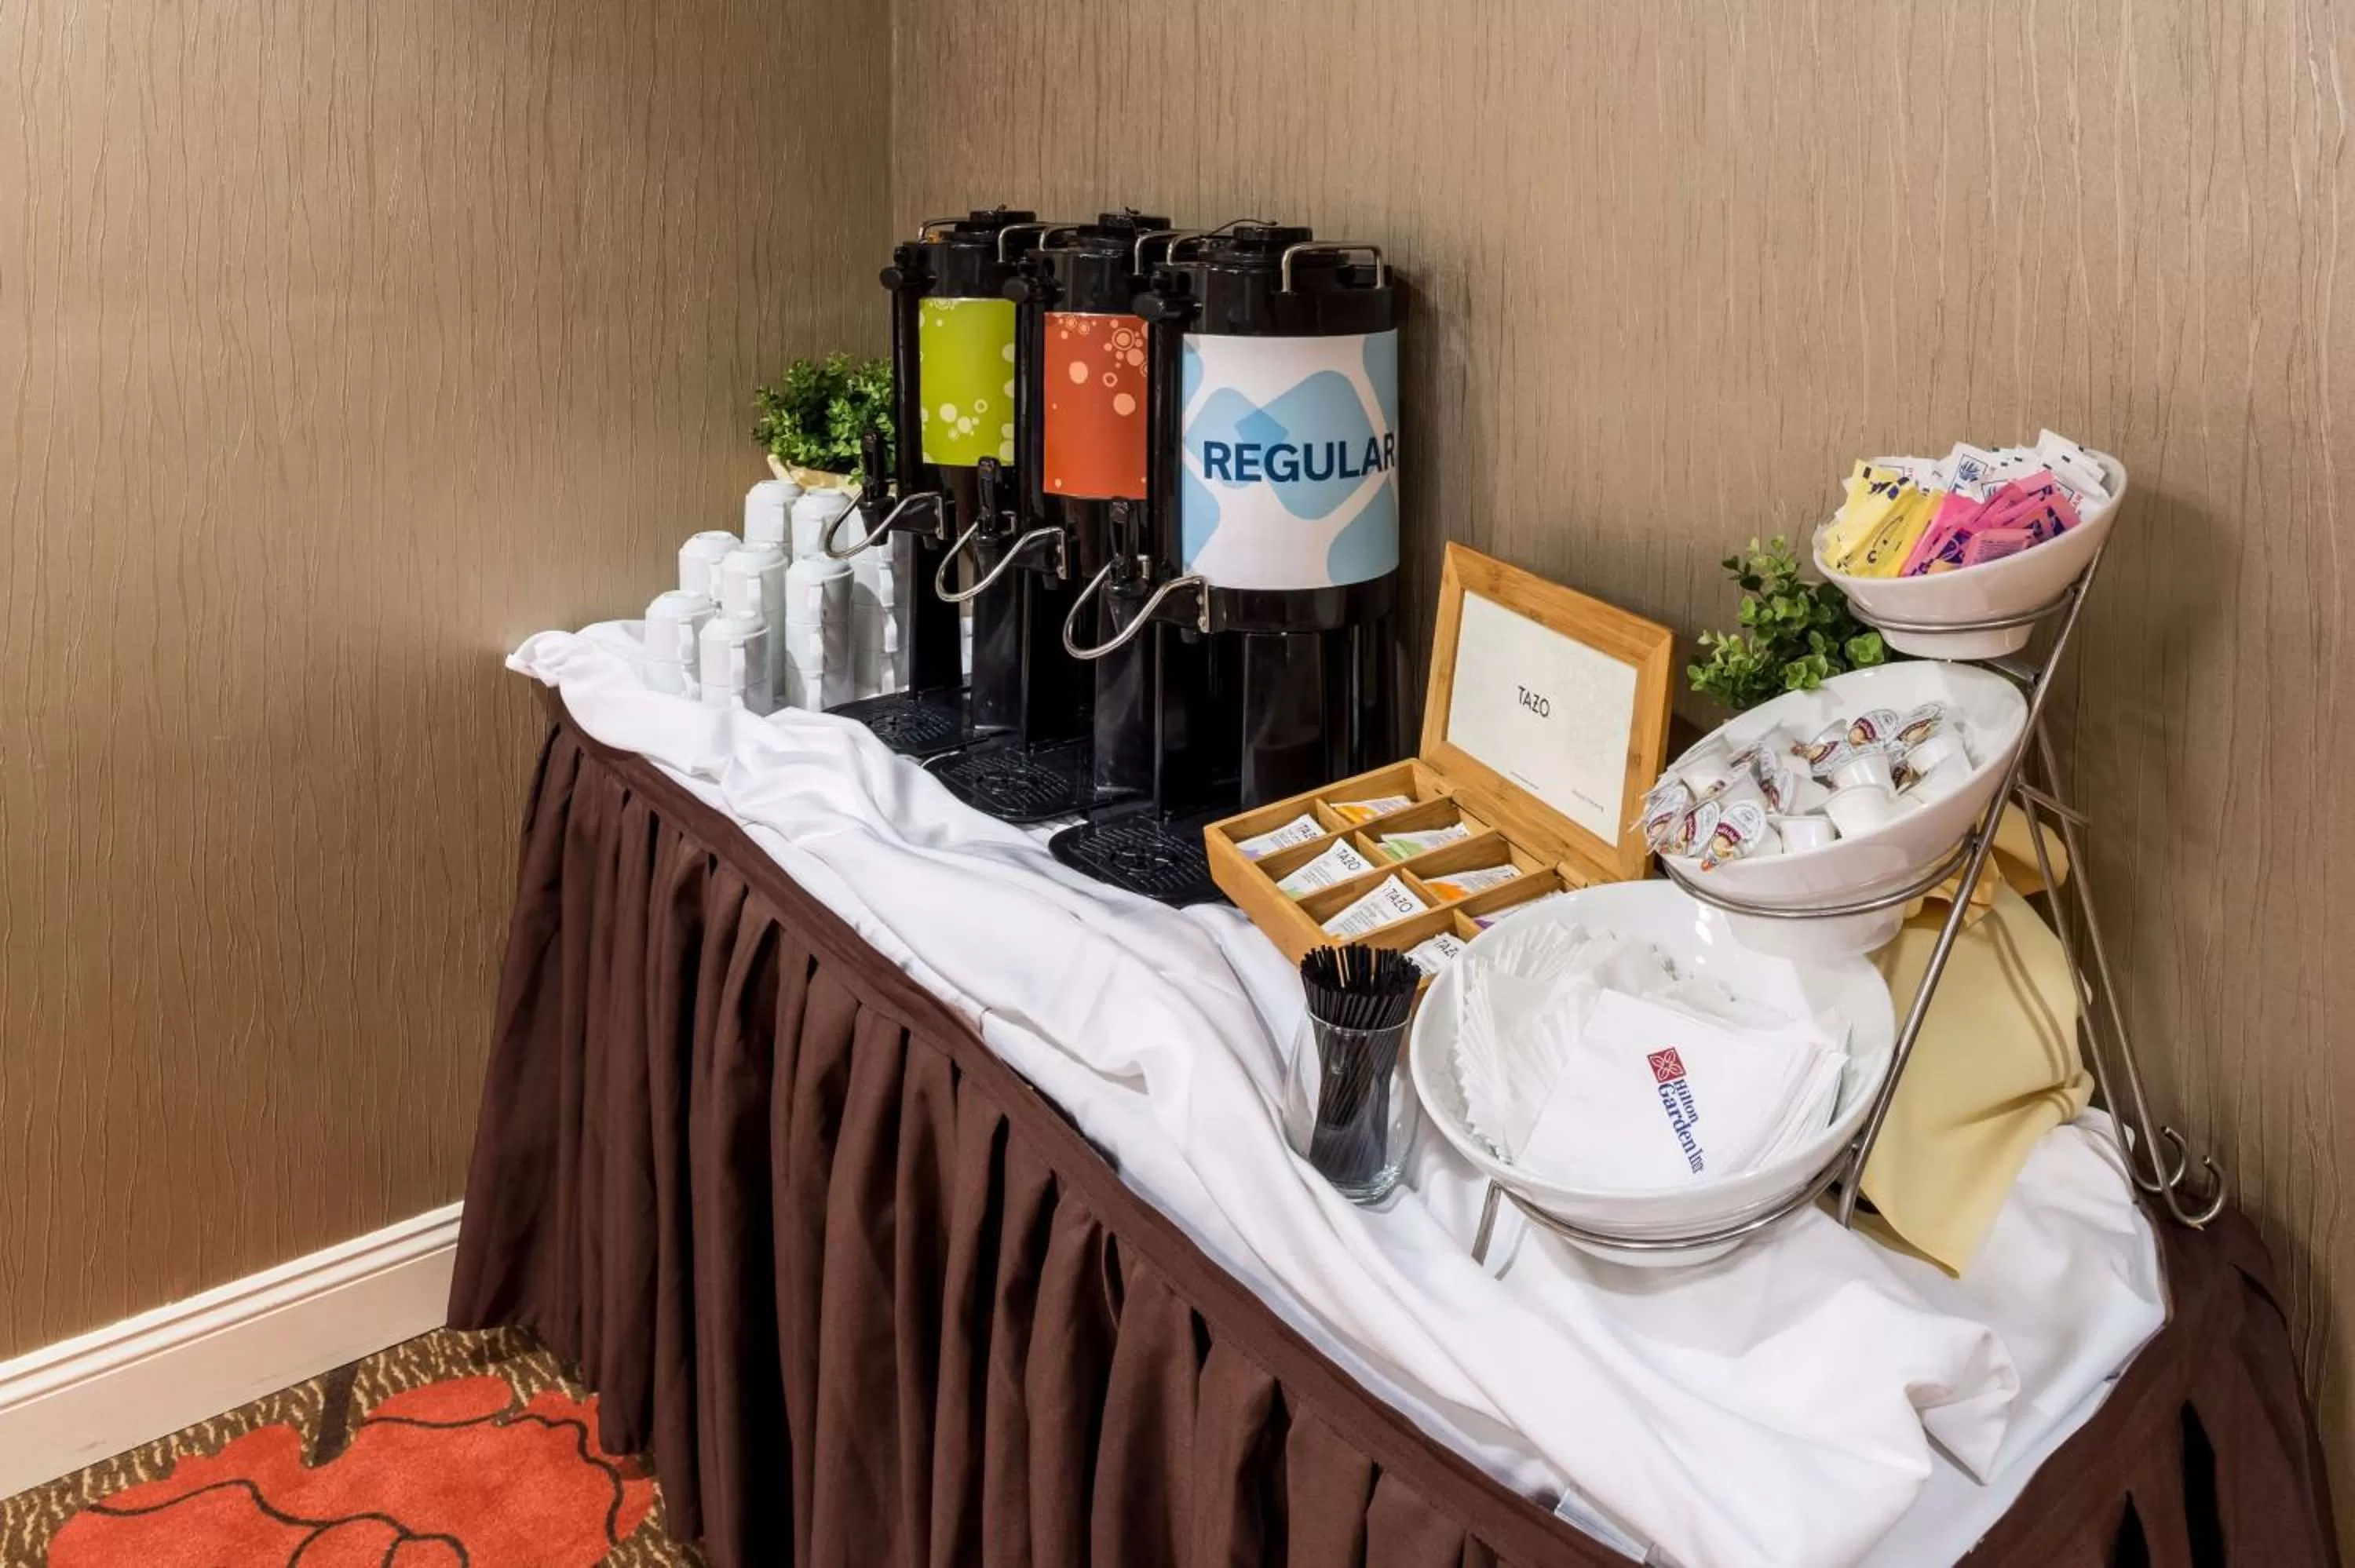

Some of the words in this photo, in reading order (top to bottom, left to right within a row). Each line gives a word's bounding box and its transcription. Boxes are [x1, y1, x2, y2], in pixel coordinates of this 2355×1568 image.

[1203, 432, 1395, 483] REGULAR
[1517, 685, 1550, 718] TAZO
[1296, 822, 1317, 840] TAZ
[1336, 848, 1361, 871] TAZO
[1385, 888, 1413, 913] TAZO
[1673, 1078, 1700, 1124] Hilton
[1657, 1083, 1697, 1154] Garden
